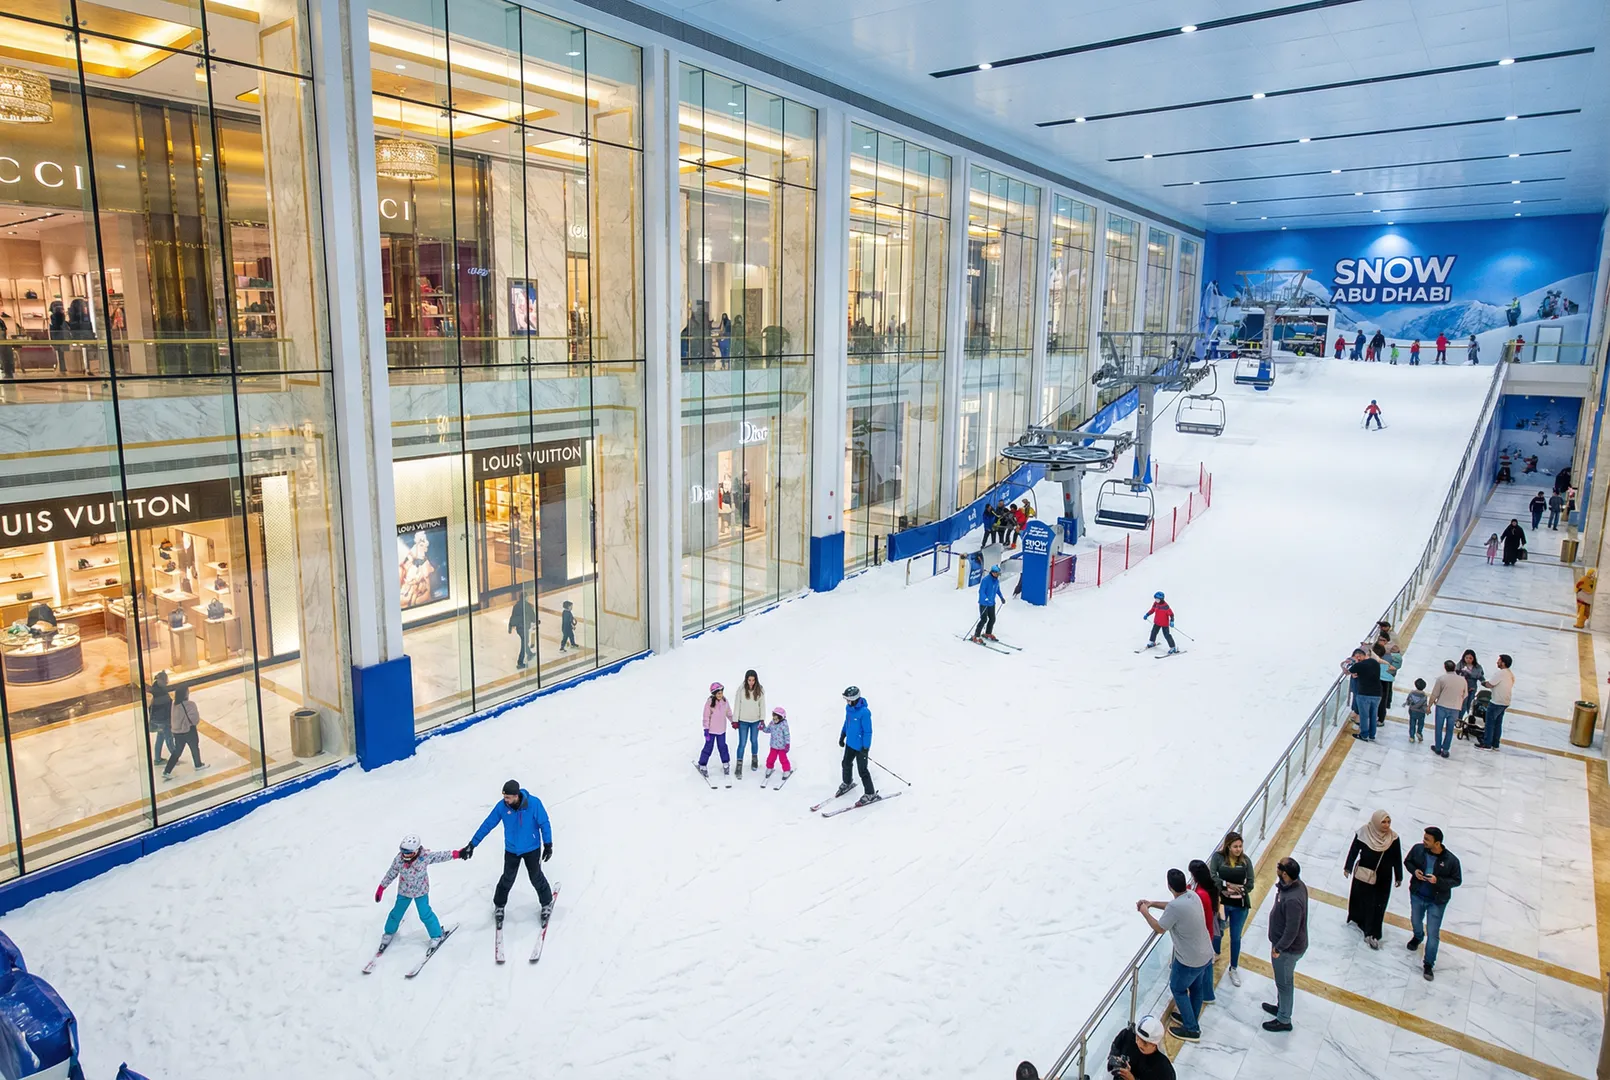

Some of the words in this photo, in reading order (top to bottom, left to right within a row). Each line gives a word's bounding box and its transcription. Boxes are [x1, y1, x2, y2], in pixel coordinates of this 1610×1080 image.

[1334, 256, 1456, 285] SNOW
[1331, 287, 1377, 303] ABU
[1382, 286, 1451, 302] DHABI
[739, 421, 768, 445] Dior
[482, 453, 523, 472] LOUIS
[527, 445, 581, 464] VUITTON
[2, 510, 53, 536] UIS
[64, 493, 191, 528] VUITTON
